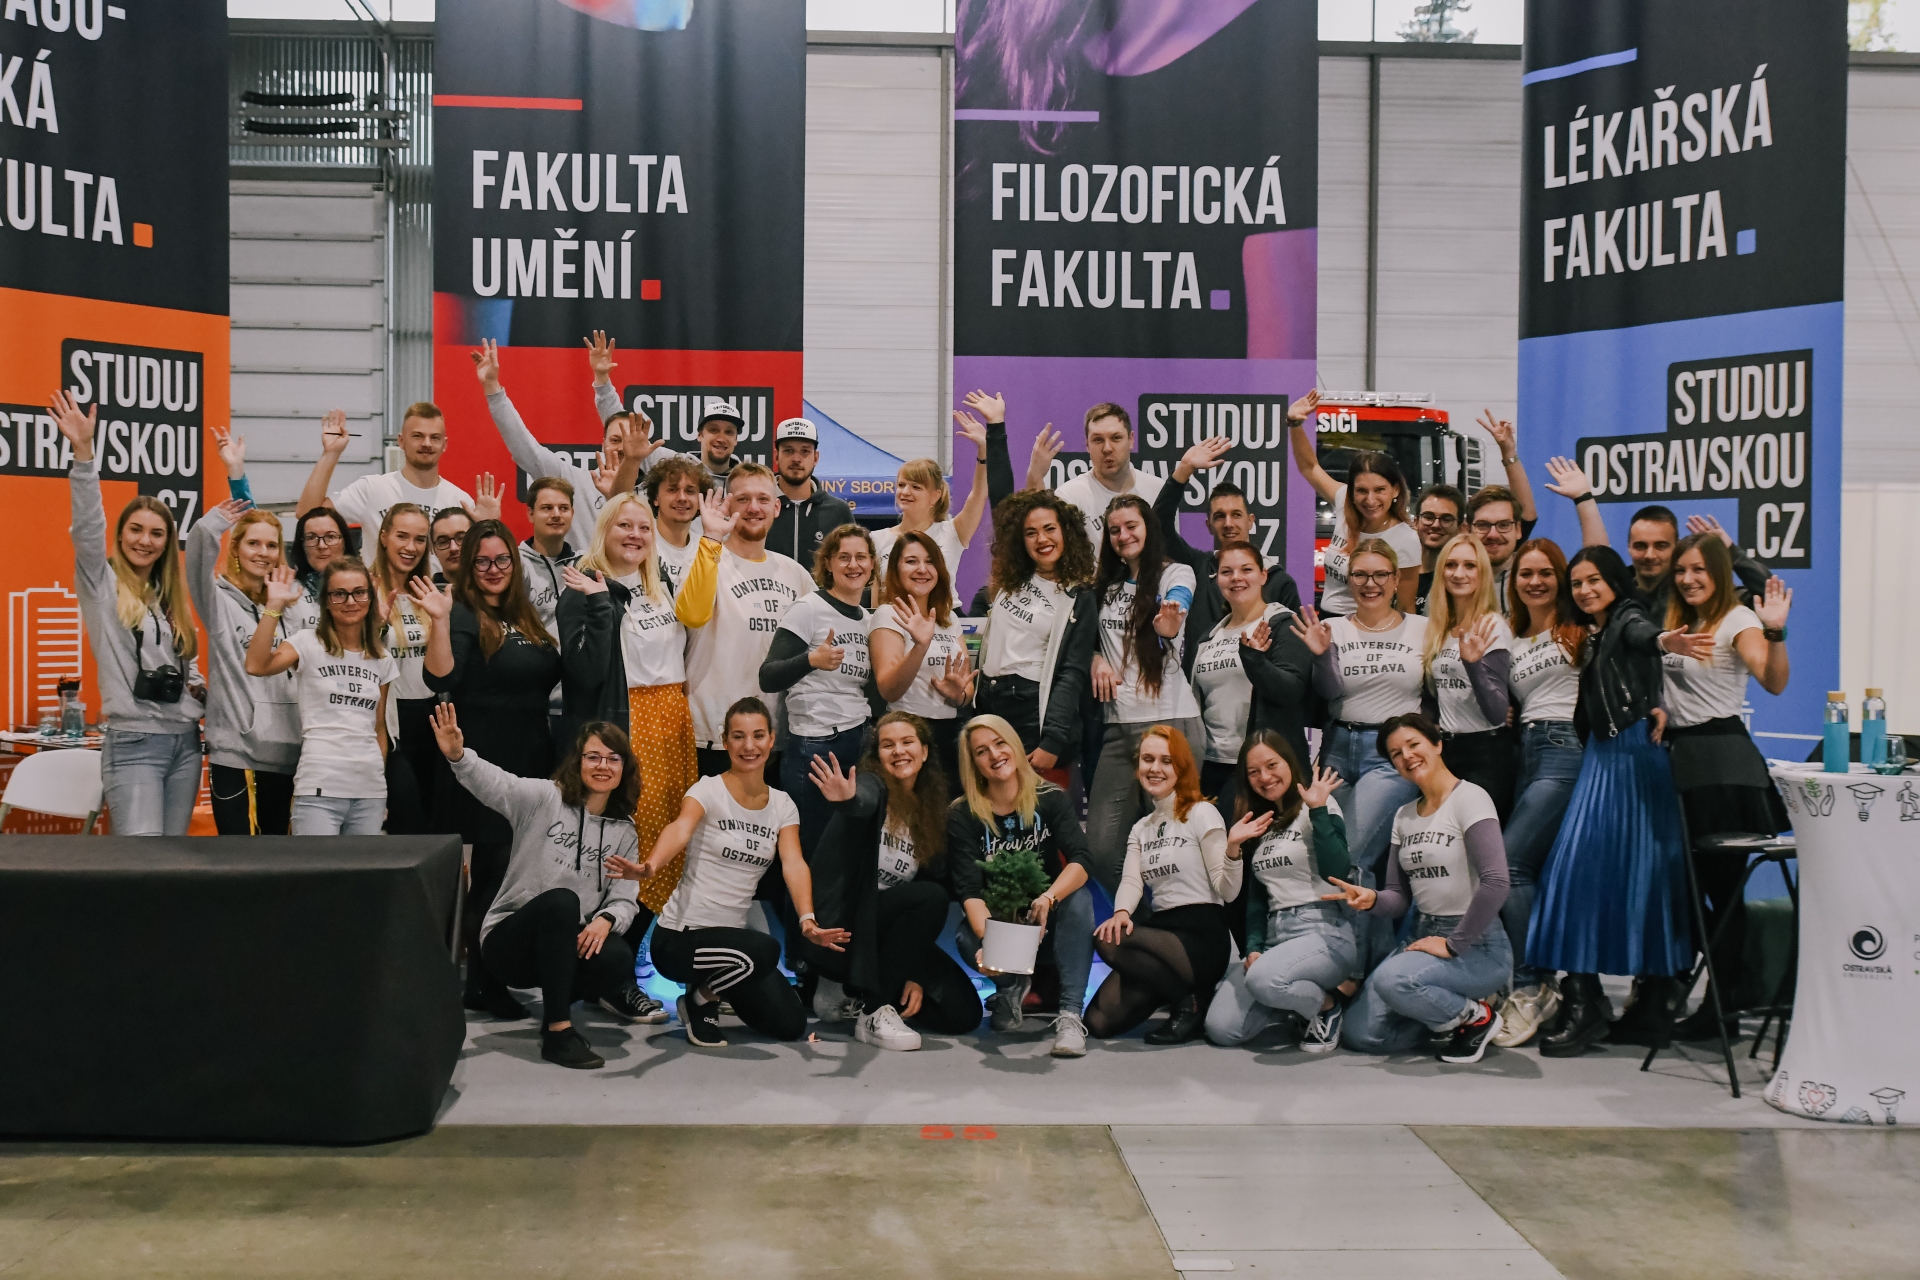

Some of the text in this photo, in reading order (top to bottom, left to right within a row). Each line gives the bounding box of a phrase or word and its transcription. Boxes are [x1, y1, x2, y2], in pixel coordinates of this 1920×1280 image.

[1543, 63, 1773, 189] LÉKAŘSKÁ
[472, 150, 689, 214] FAKULTA
[991, 156, 1286, 225] FILOZOFICKÁ
[70, 349, 199, 413] STUDUJ
[1674, 361, 1806, 426] STUDUJ
[1146, 403, 1281, 449] STUDUJ
[1316, 408, 1358, 433] SIČI
[1584, 432, 1806, 497] OSTRAVSKOU
[821, 477, 895, 494] NÝ SBOR
[1746, 503, 1806, 559] .CZ
[1333, 554, 1347, 567] OF
[764, 600, 779, 613] OF
[831, 633, 869, 647] UNIVERS
[1340, 641, 1414, 654] UNIVERSITY
[855, 651, 867, 662] OF
[940, 646, 952, 654] OF
[1366, 654, 1384, 662] OF
[1196, 657, 1238, 674] OSTRAVA
[1343, 664, 1406, 677] OSTRAVA
[1513, 653, 1570, 683] OSTRAVA
[348, 682, 363, 693] OF
[329, 693, 377, 711] OSTRAVA
[717, 819, 776, 841] UNIVERSI
[746, 838, 760, 851] OF
[1400, 831, 1456, 849] IVERSITY
[721, 847, 773, 868] OSTRAVA
[1262, 844, 1275, 856] OF
[1411, 850, 1423, 864] OF
[894, 858, 910, 873] OF
[1149, 853, 1161, 865] OF
[1253, 855, 1294, 872] STRAVA
[1140, 863, 1181, 881] STRAVA
